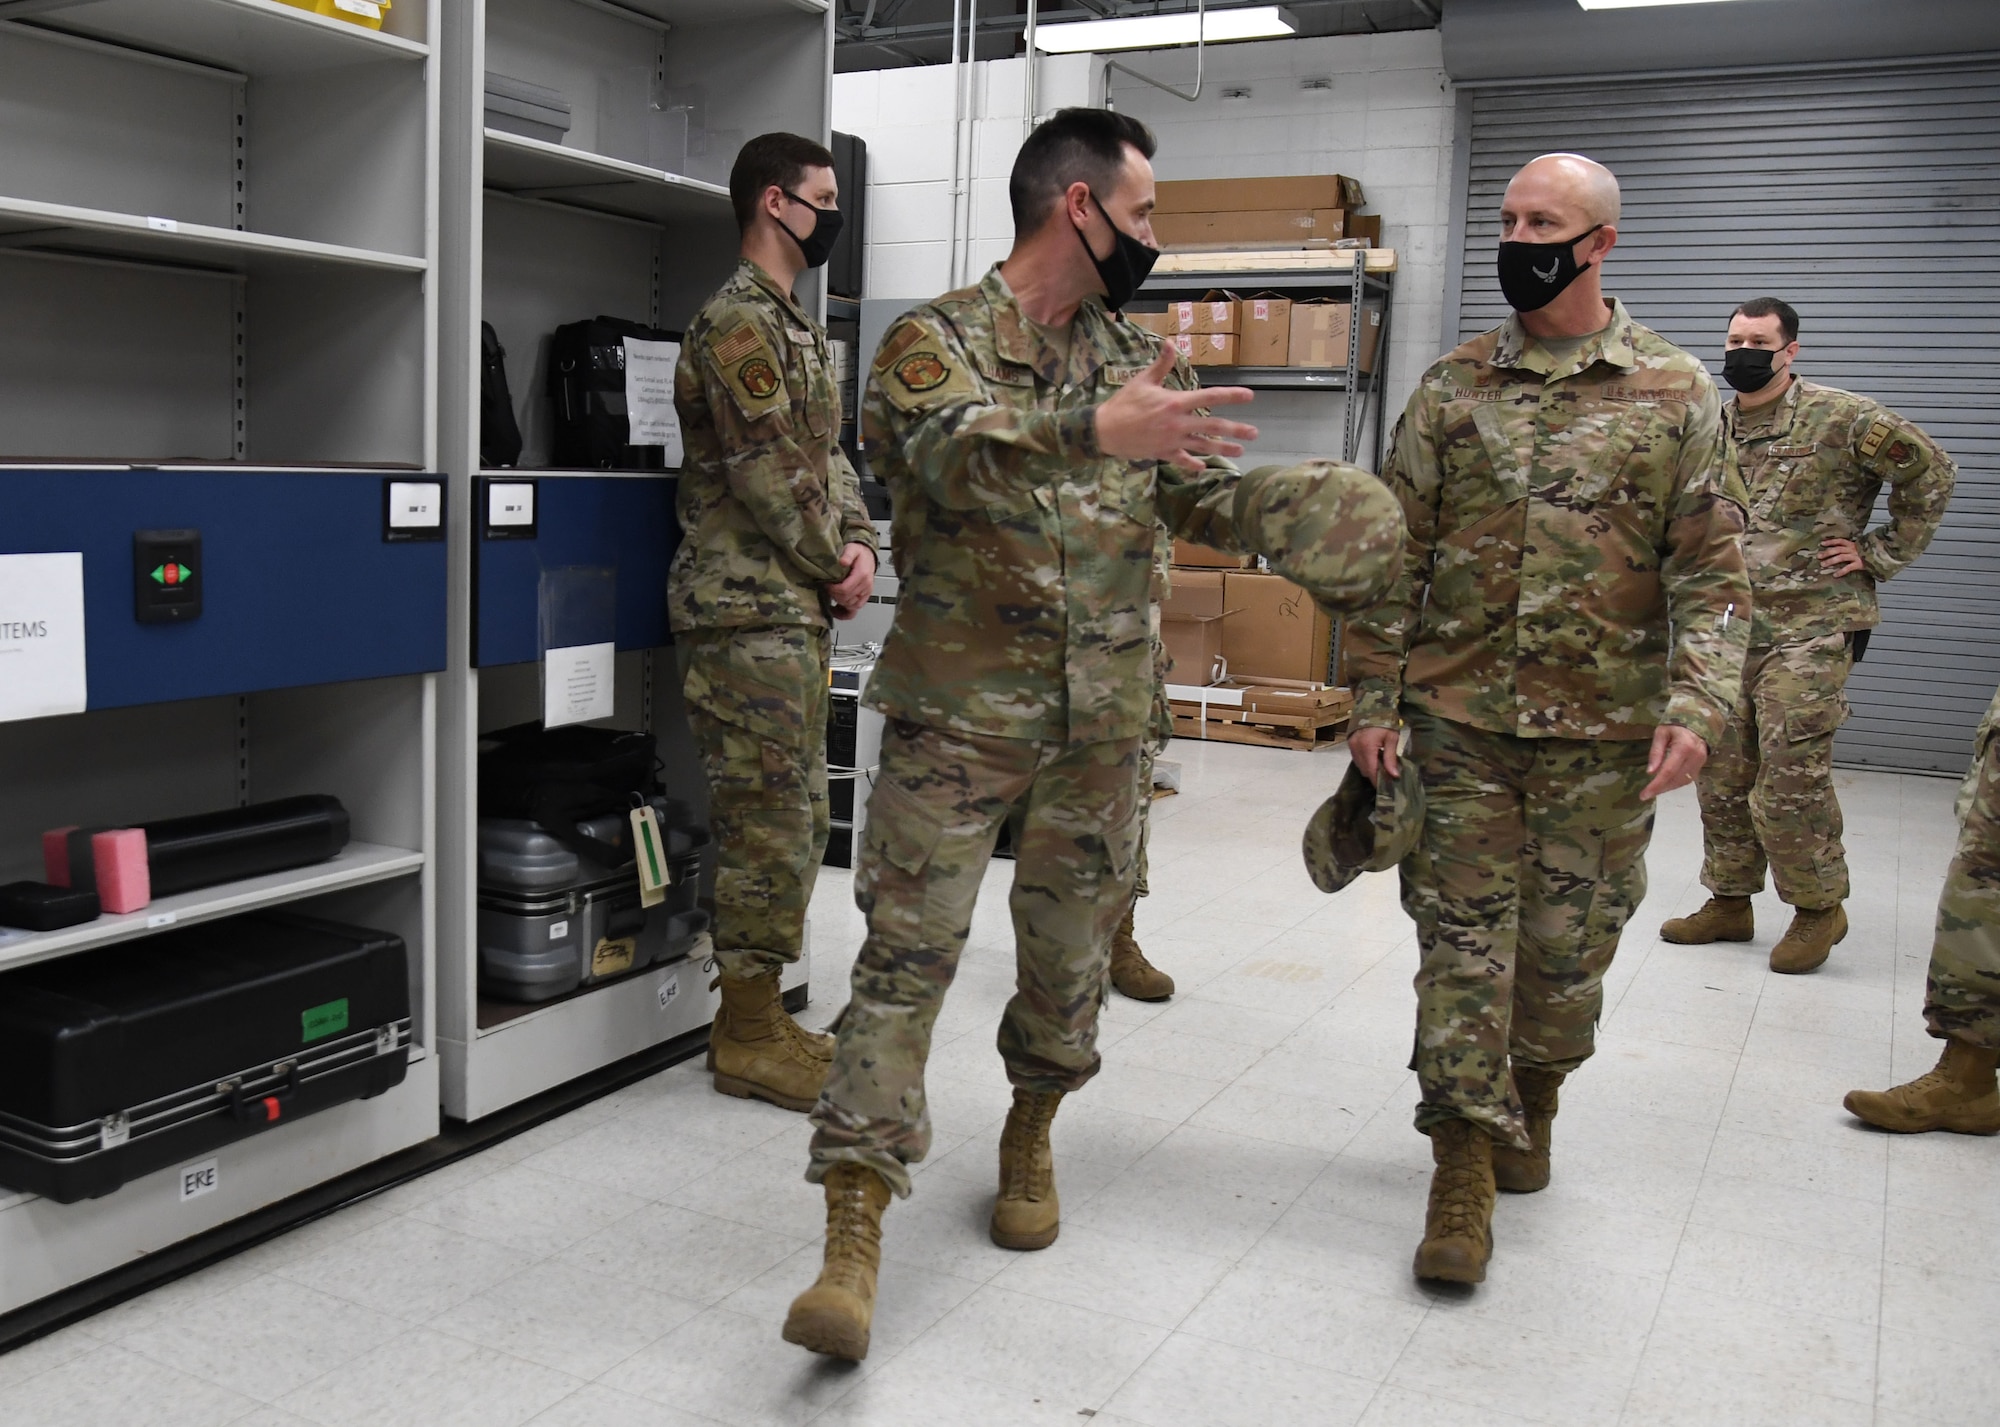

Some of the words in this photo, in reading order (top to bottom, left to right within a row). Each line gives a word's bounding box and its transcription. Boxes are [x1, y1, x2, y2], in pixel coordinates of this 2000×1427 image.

[1455, 388, 1502, 401] HUNTER
[1631, 388, 1648, 400] AIR
[1652, 388, 1687, 401] FORCE
[1865, 431, 1883, 448] EI
[1279, 589, 1303, 620] PL
[185, 1167, 215, 1195] ERE
